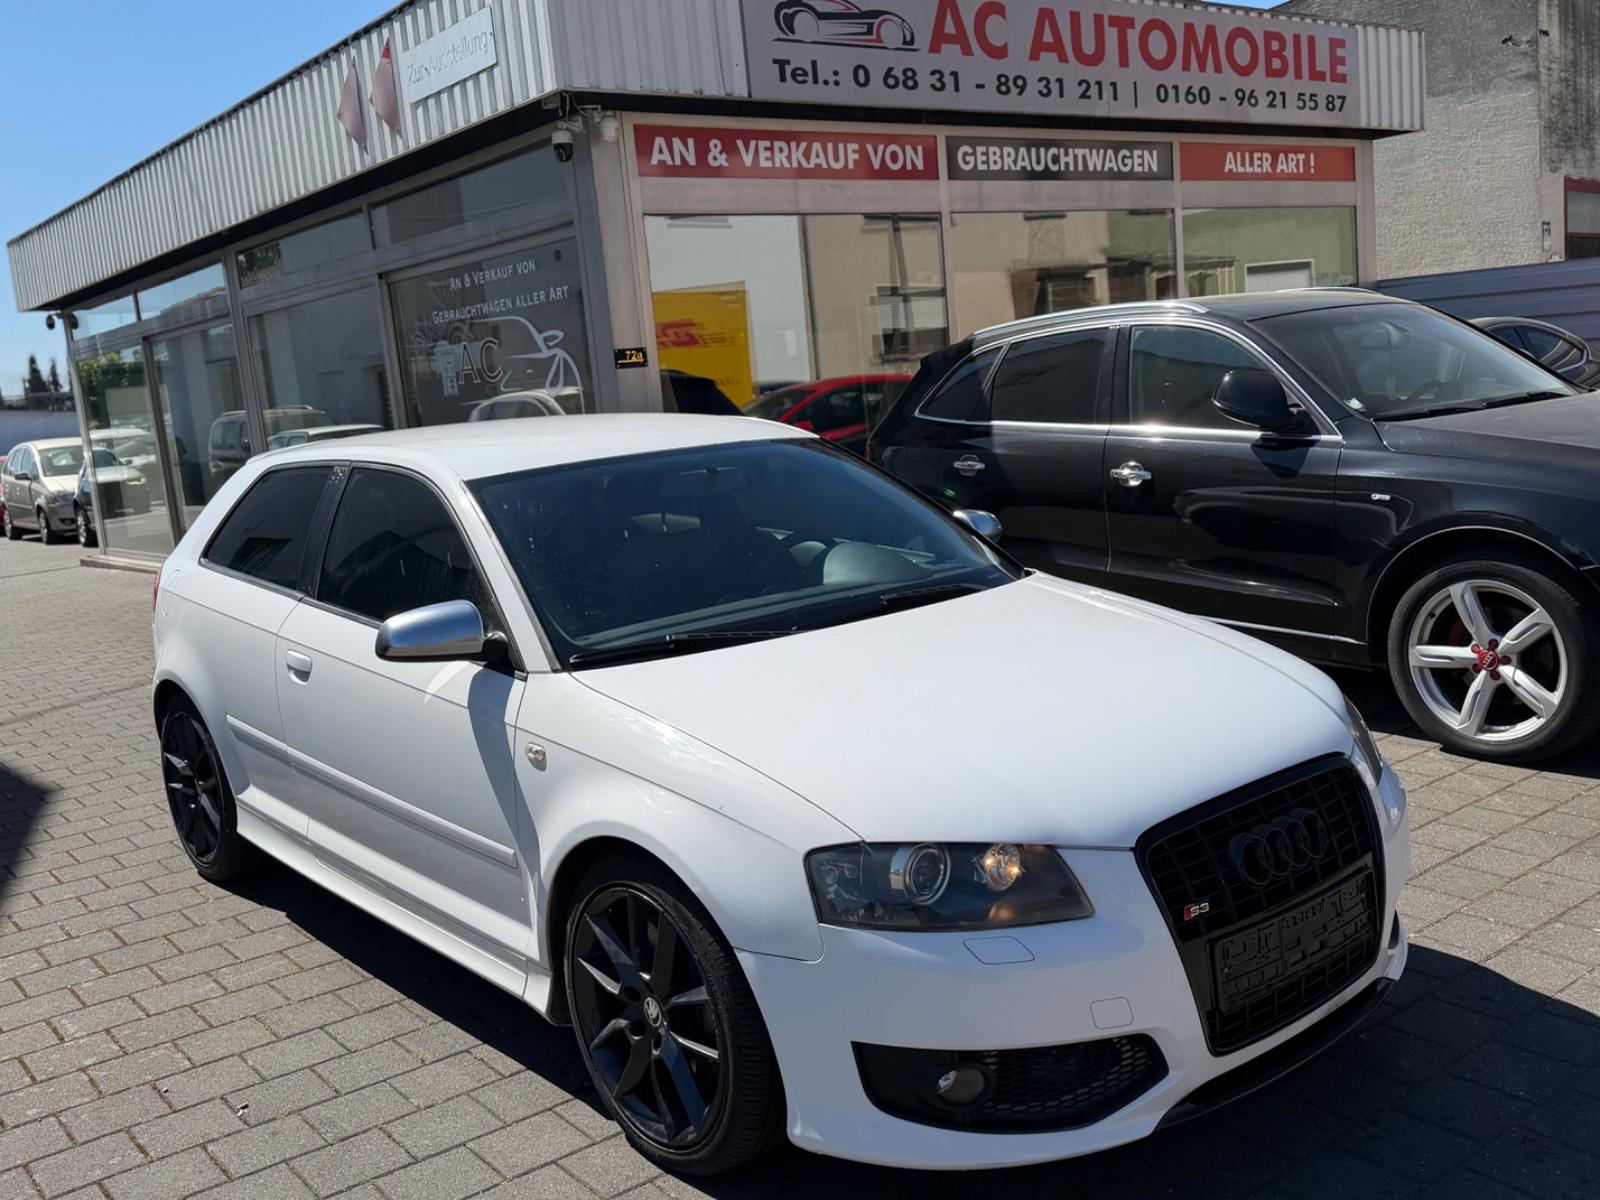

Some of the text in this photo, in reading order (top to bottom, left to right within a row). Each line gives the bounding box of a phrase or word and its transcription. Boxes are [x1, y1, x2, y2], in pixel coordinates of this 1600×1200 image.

[928, 0, 1348, 83] AC AUTOMOBILE
[772, 58, 841, 87] Tel.:
[852, 64, 871, 88] 0
[882, 66, 920, 91] 68
[929, 69, 960, 94] 31
[995, 73, 1028, 97] 89
[1037, 76, 1064, 99] 31
[1077, 79, 1119, 102] 211
[1155, 84, 1211, 106] 0160
[1234, 88, 1259, 108] 96
[1266, 90, 1287, 110] 21
[1297, 92, 1319, 112] 55
[1325, 94, 1347, 113] 87
[650, 137, 924, 170] AN & VERKAUF VON
[957, 145, 1159, 172] GEBRAUCHTWAGEN
[1224, 151, 1272, 174] ALLER
[1276, 153, 1305, 174] ART
[516, 259, 536, 275] VON
[515, 291, 546, 307] ALLER
[458, 337, 504, 385] AC
